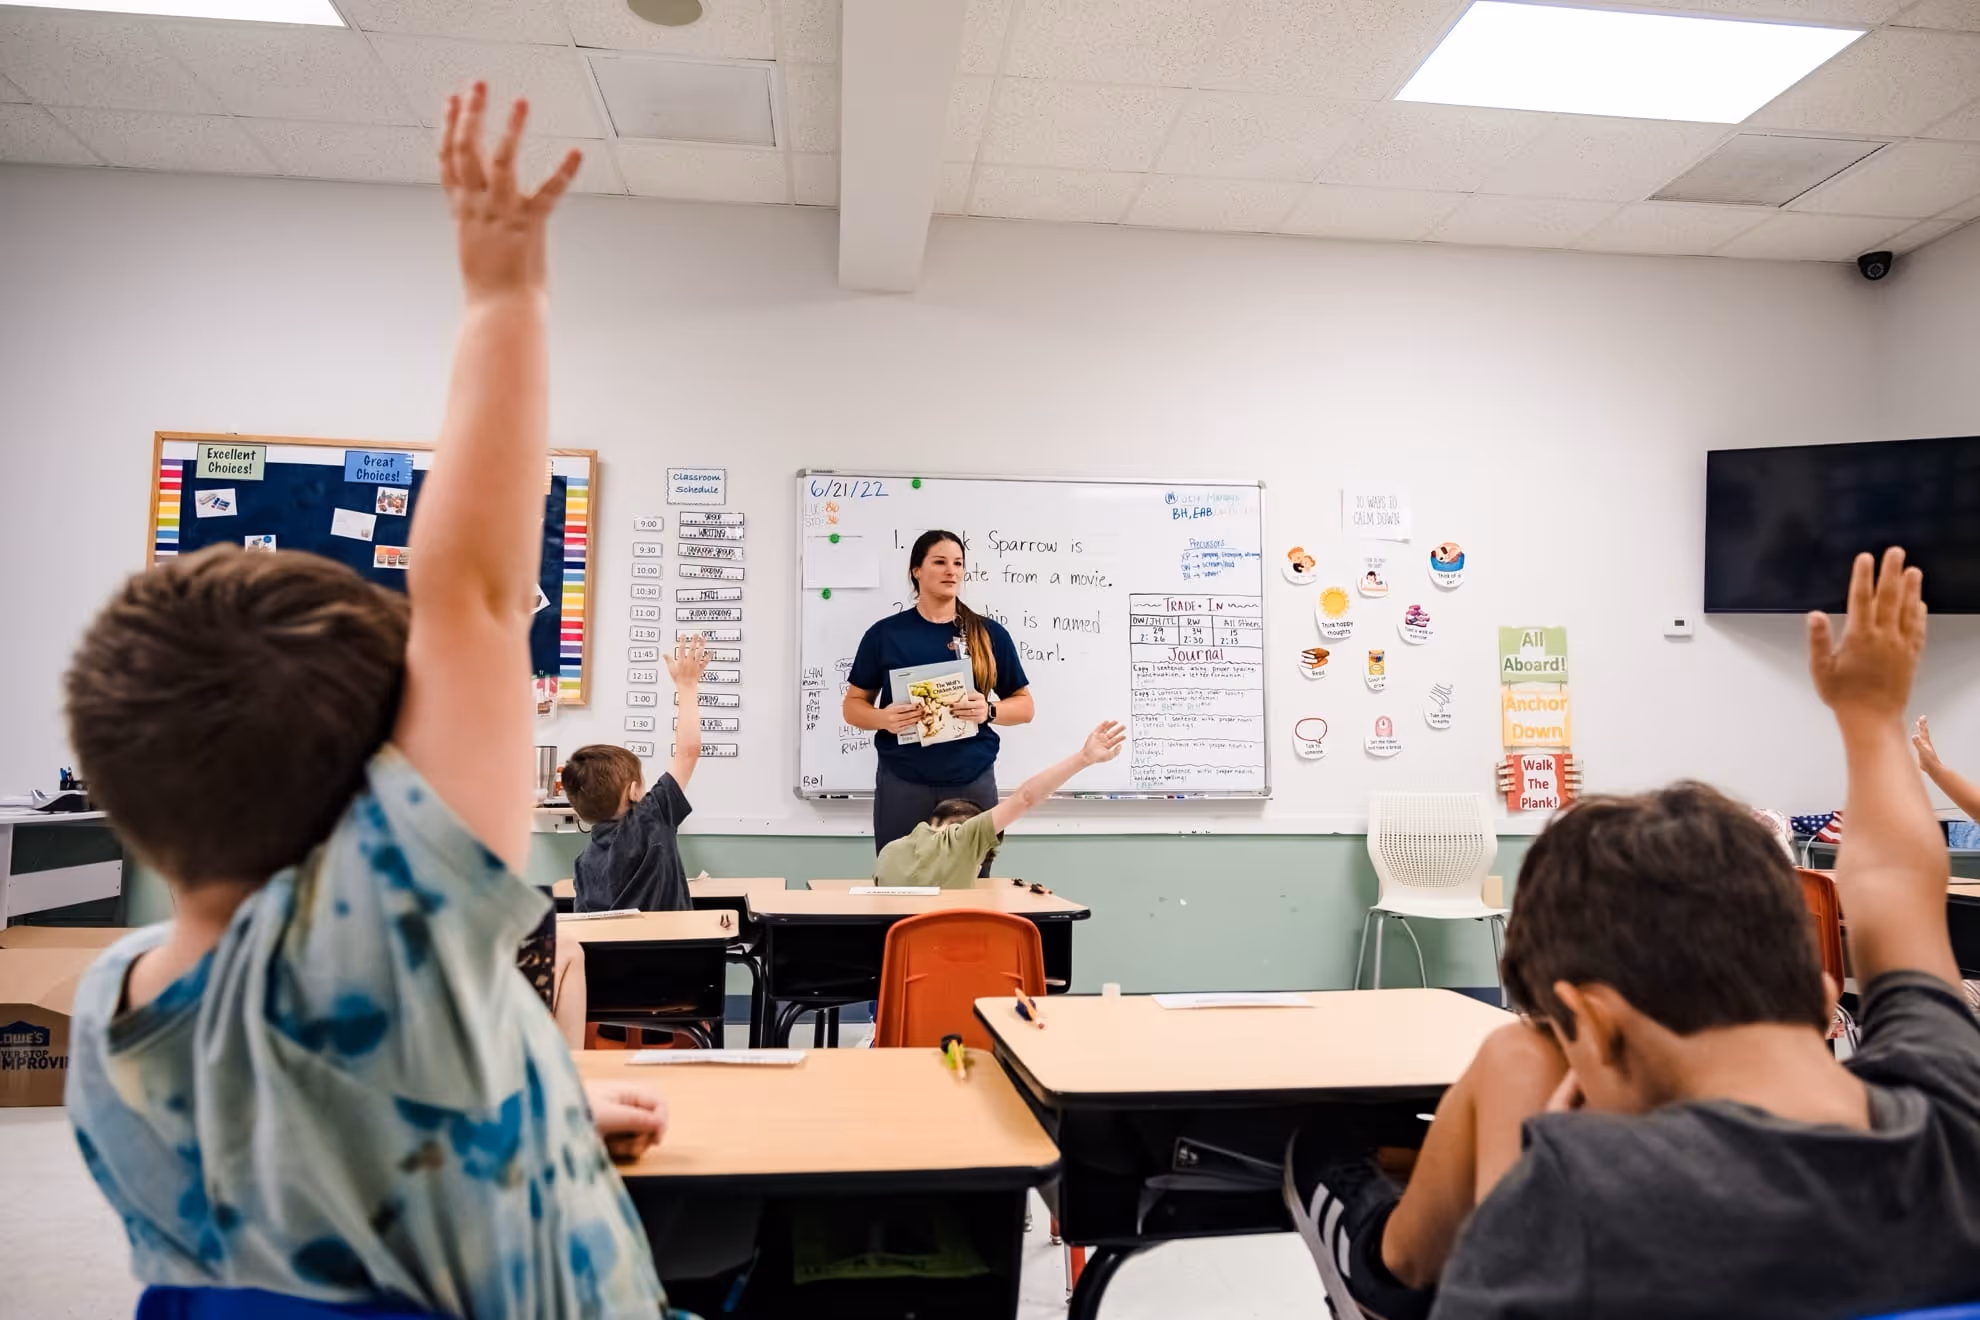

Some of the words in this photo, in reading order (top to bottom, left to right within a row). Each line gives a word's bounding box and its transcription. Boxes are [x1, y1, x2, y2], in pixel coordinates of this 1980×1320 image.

[207, 447, 256, 461] Excellent
[363, 454, 395, 467] Great
[208, 462, 253, 474] Choices!
[356, 468, 400, 482] Choices!
[673, 473, 721, 481] Classroom
[675, 485, 719, 494] Schedule
[810, 480, 889, 498] 6/21/22
[1367, 495, 1386, 509] WAYS
[1389, 496, 1398, 509] TO
[1353, 511, 1374, 525] CALM
[1377, 511, 1400, 525] DOWN
[988, 529, 1058, 559] Sparrow
[1071, 538, 1083, 554] is
[964, 562, 989, 582] ate
[1002, 564, 1038, 584] from
[1049, 572, 1061, 584] a
[1070, 570, 1113, 588] movie.
[981, 604, 1008, 626] hip
[1024, 610, 1038, 629] is
[1053, 610, 1101, 634] named
[1153, 627, 1164, 635] 29
[1521, 631, 1544, 648] All
[1020, 641, 1065, 662] Pearl.
[1168, 647, 1224, 661] Journal
[1503, 657, 1566, 672] Aboard!
[1505, 695, 1567, 712] Anchor
[1512, 724, 1563, 739] Down
[1522, 759, 1553, 771] Walk
[1528, 778, 1550, 789] The
[1521, 797, 1558, 809] Plank!
[0, 1032, 44, 1044] OWE'S
[0, 1055, 69, 1070] MPROVI
